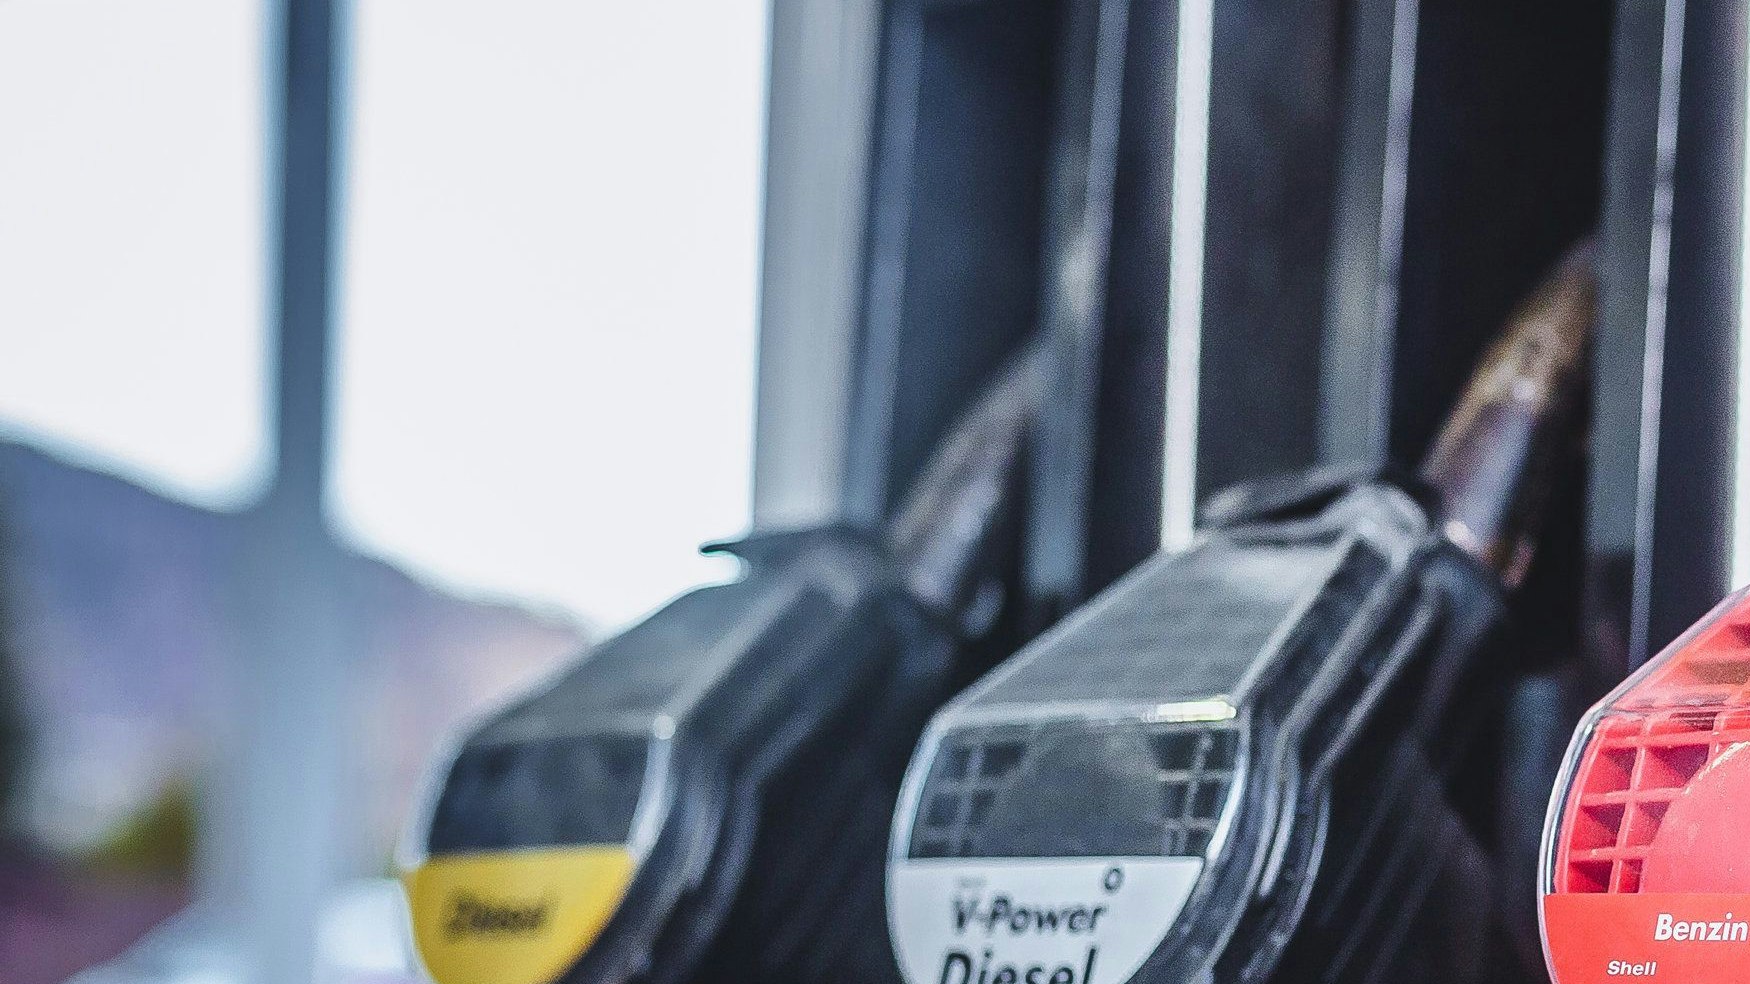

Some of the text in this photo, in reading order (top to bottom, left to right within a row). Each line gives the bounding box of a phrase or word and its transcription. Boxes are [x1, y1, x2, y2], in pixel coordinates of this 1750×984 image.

[953, 895, 1104, 934] V-Power
[1654, 912, 1749, 943] Benzin
[1607, 960, 1657, 977] Shell
